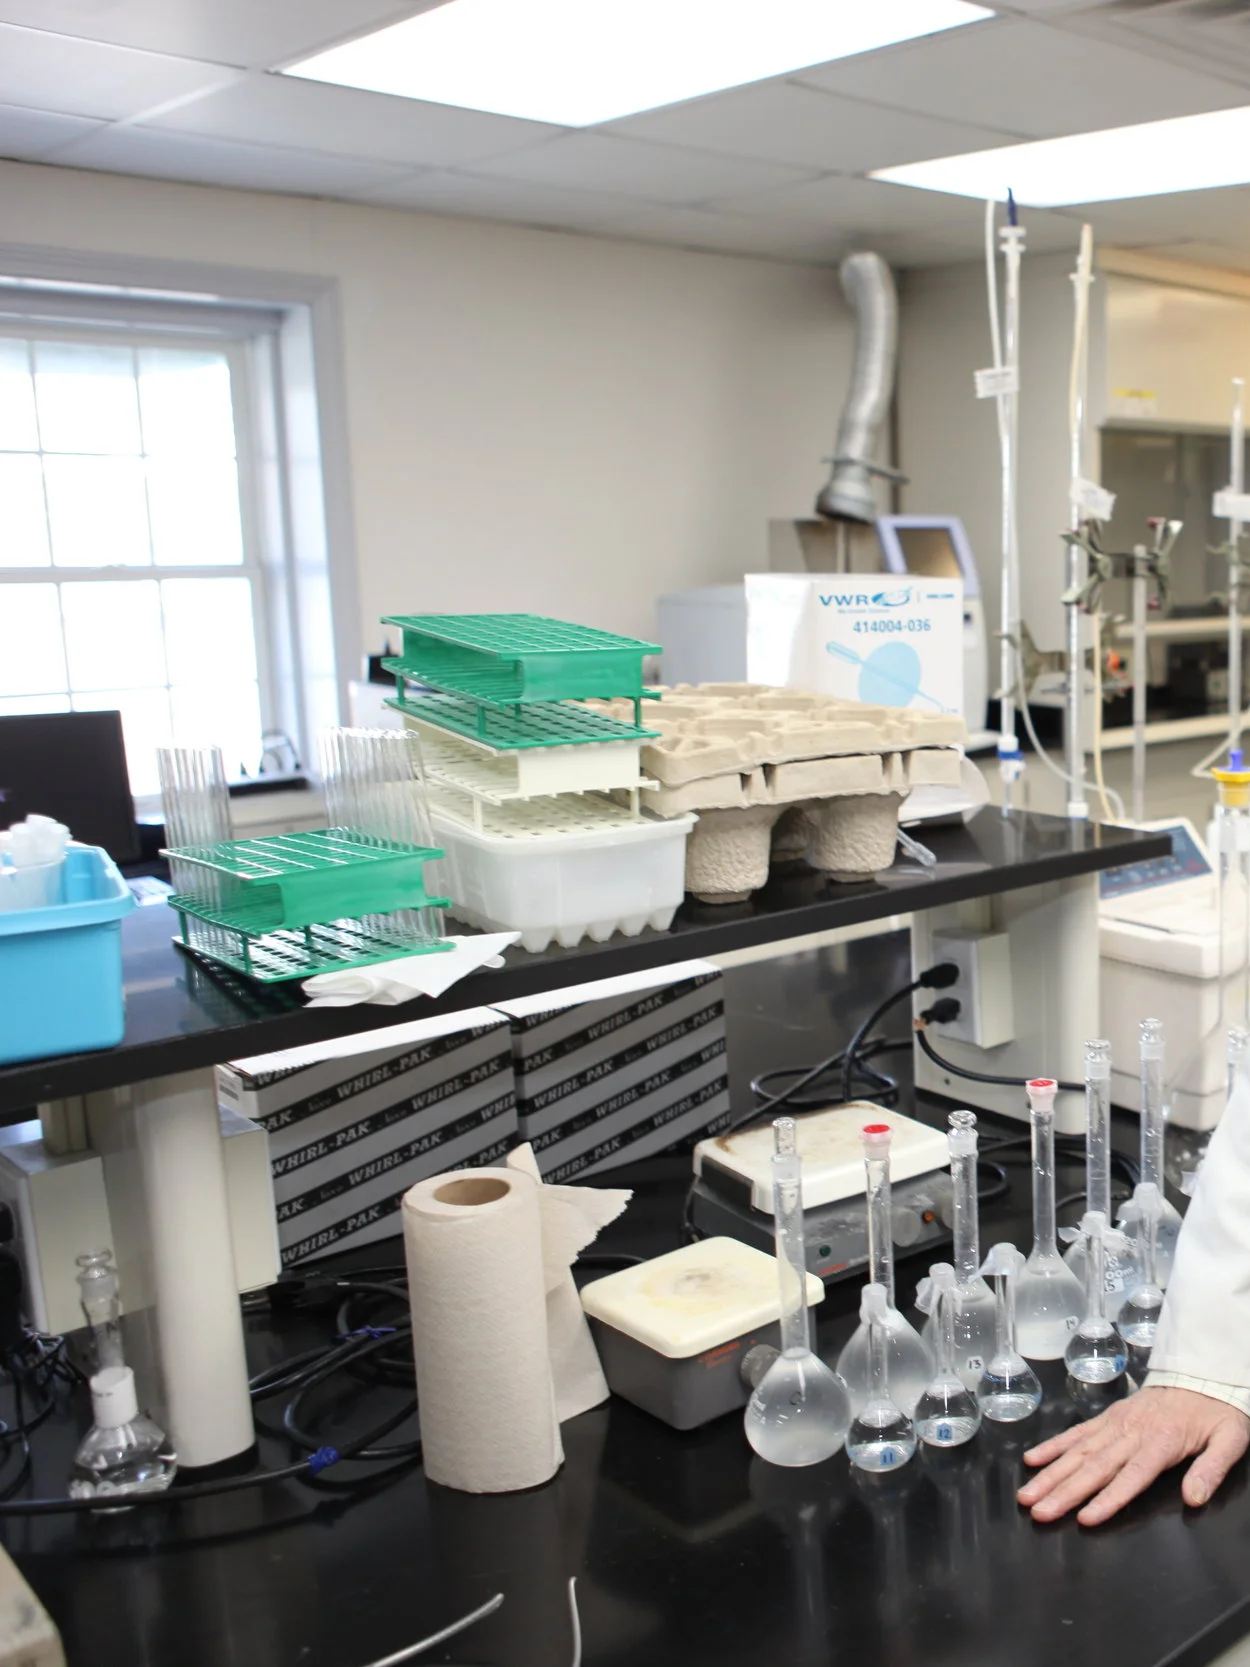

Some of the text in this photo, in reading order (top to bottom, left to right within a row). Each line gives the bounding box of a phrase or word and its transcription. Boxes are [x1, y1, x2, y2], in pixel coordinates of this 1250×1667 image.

[819, 594, 869, 606] VWR
[853, 619, 931, 633] 414004-036
[587, 995, 665, 1039] WHIRL-PAK
[647, 1007, 717, 1051] WHIRL-PAK
[336, 1046, 432, 1098] WHIRL-PAK
[411, 1059, 500, 1110] WHIRL-PAK
[534, 1060, 614, 1108] WHIRL-PAK
[596, 1070, 671, 1116] WHIRL-PAK
[653, 1081, 722, 1127] WHIRL-PAK
[348, 1130, 445, 1185] WHIRL-PAK
[282, 1205, 380, 1263] WHIRL-PAK
[968, 1359, 981, 1370] 13
[938, 1428, 950, 1439] 12
[883, 1452, 893, 1464] 11
